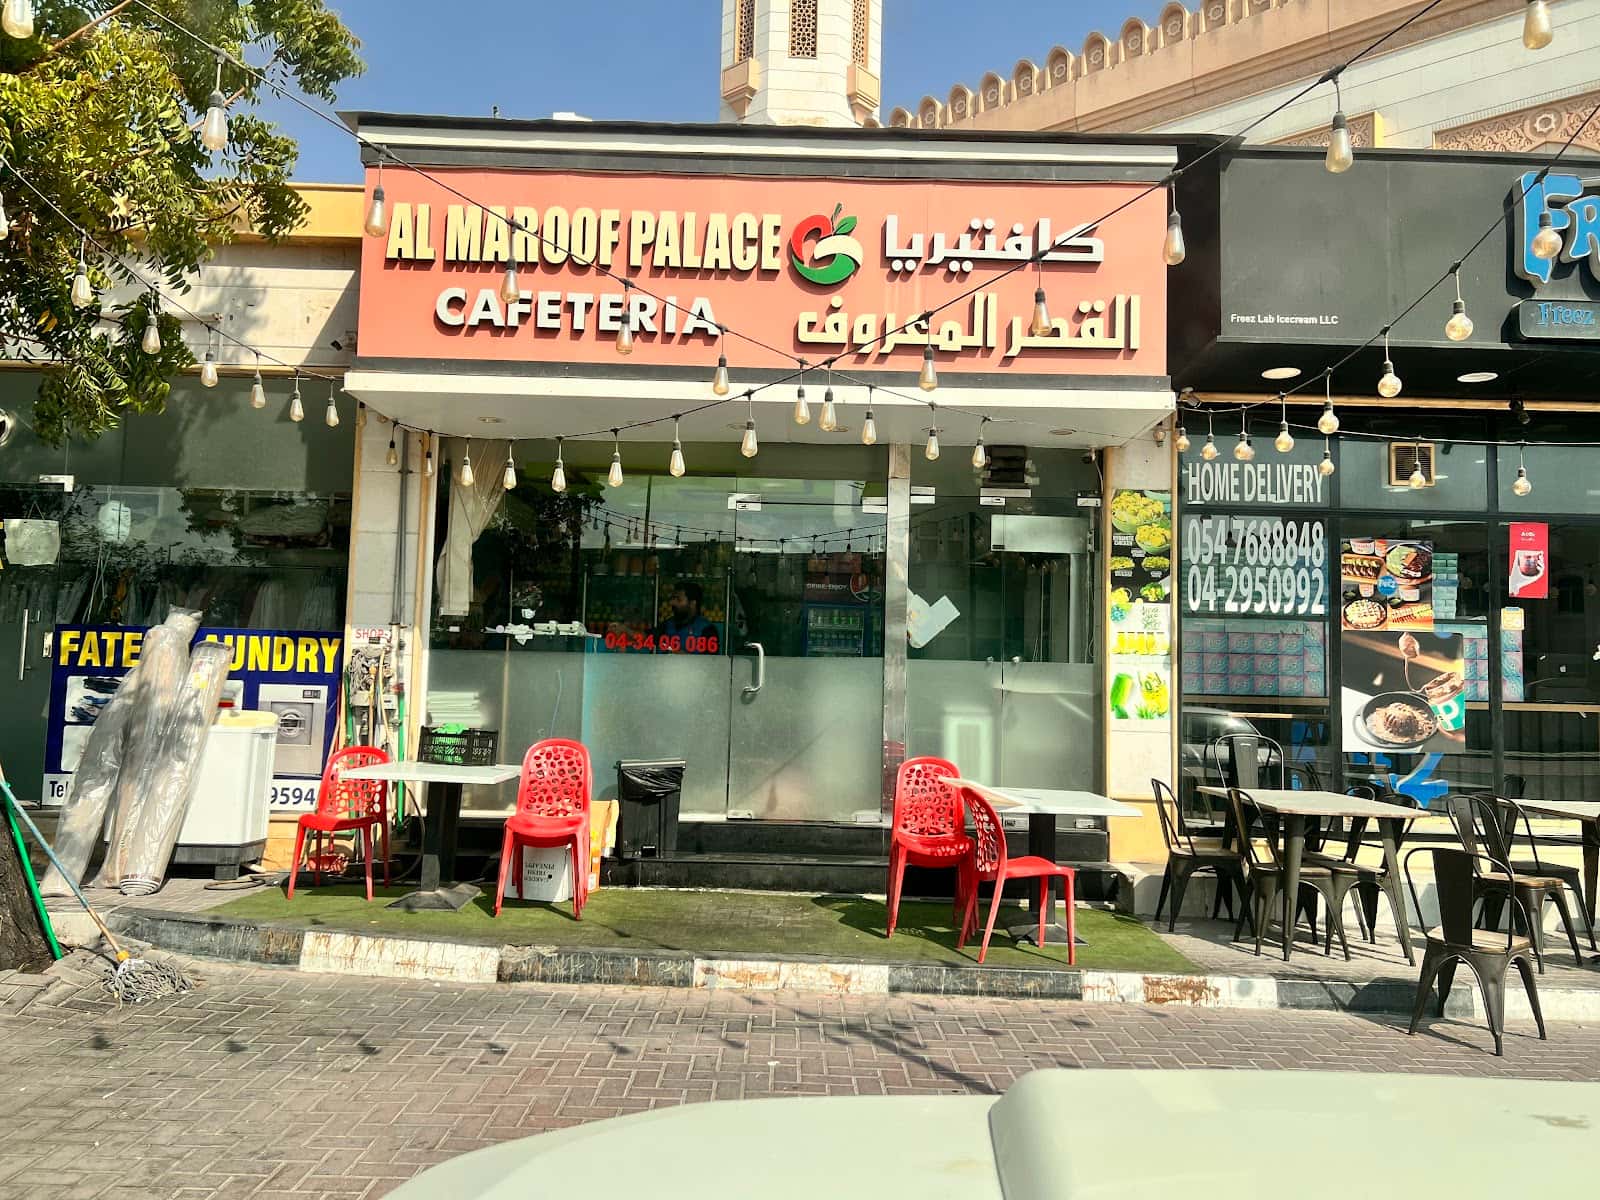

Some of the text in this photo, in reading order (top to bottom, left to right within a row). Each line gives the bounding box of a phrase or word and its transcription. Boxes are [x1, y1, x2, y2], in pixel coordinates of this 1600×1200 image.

[386, 202, 782, 271] AL MAROOF PALACE
[884, 214, 1105, 273] كافتيريا
[435, 287, 723, 336] CAFETERIA
[797, 291, 998, 355] المعروف
[1230, 313, 1339, 325] Freez Lab Icecream LLC
[1536, 302, 1595, 326] Freez
[1188, 462, 1324, 503] HOME DELIVERY
[1187, 564, 1325, 615] 04-2950992
[685, 635, 719, 653] 086
